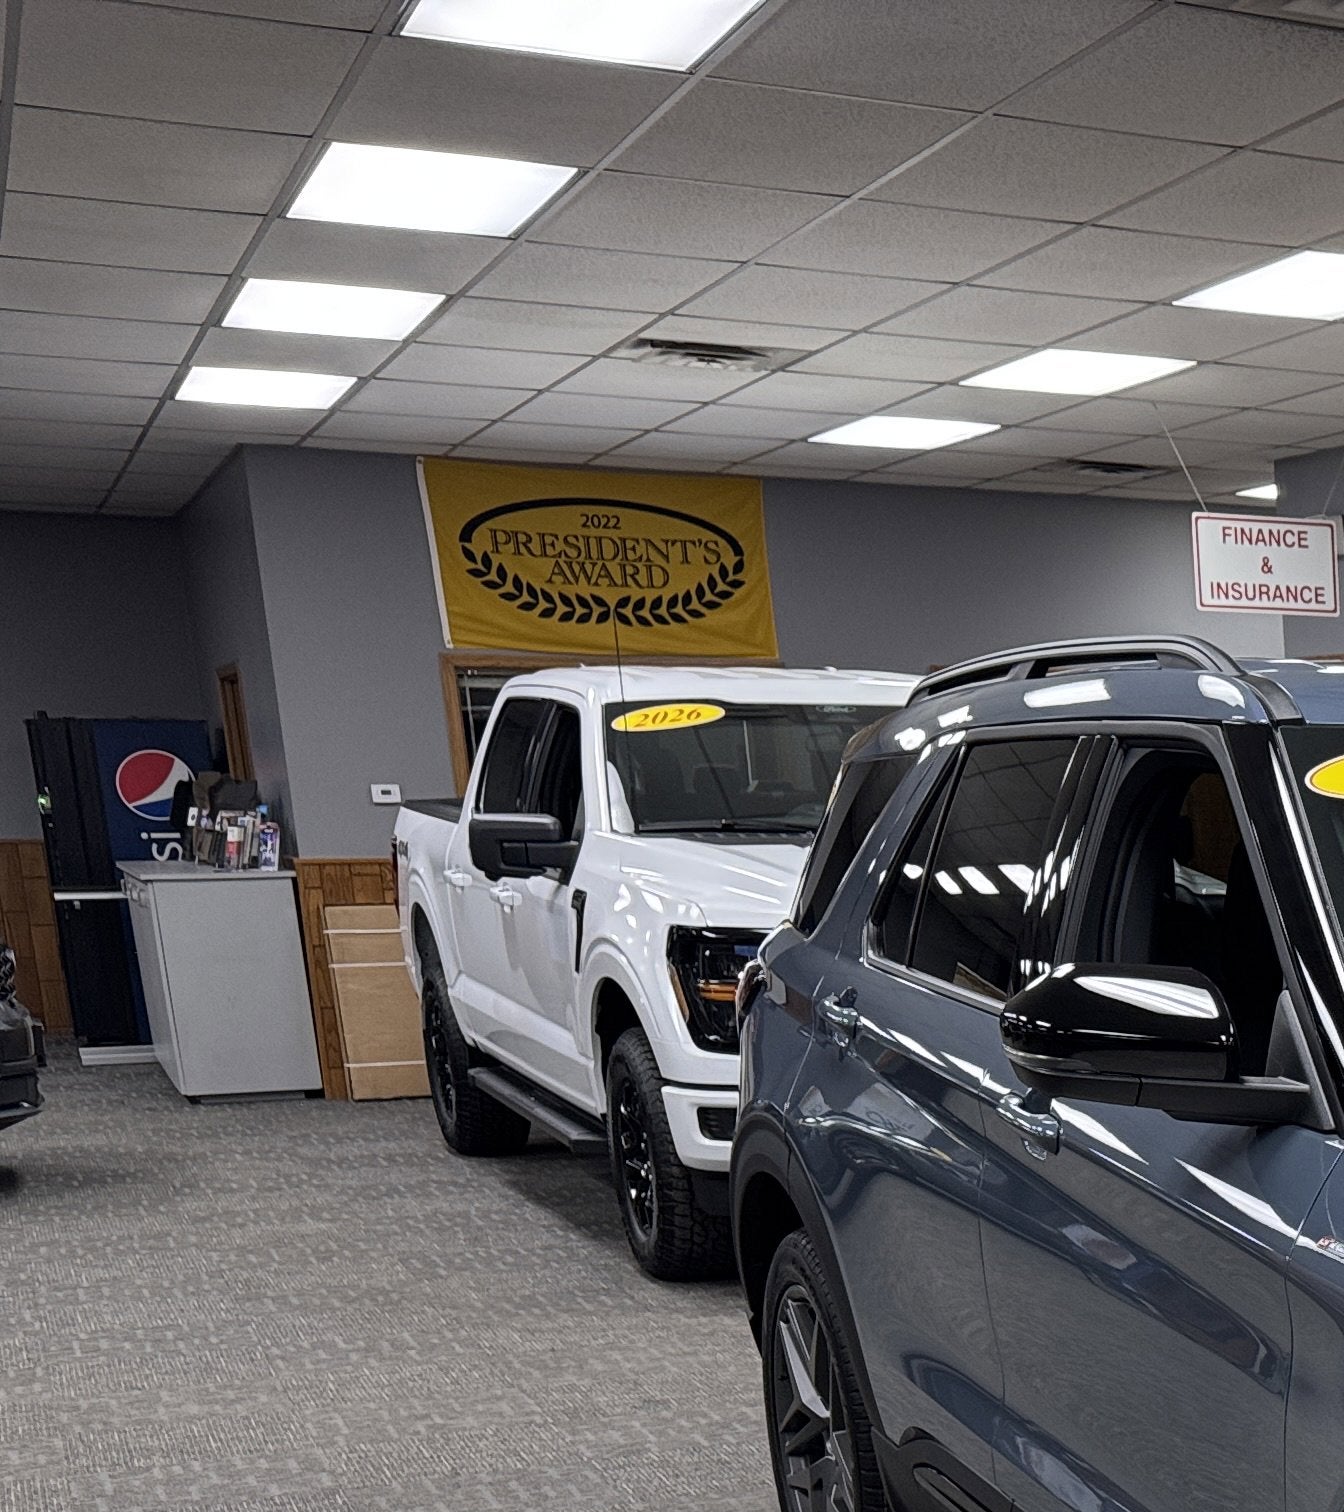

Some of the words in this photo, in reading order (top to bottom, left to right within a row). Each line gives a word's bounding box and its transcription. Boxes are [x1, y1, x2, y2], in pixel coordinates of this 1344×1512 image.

[580, 513, 622, 530] 2022
[487, 527, 722, 565] PRESIDENT'S
[1222, 526, 1309, 549] FINANCE
[544, 560, 670, 590] AWARD
[1261, 556, 1273, 574] &
[1210, 581, 1326, 604] INSURANCE
[633, 708, 701, 728] 2026
